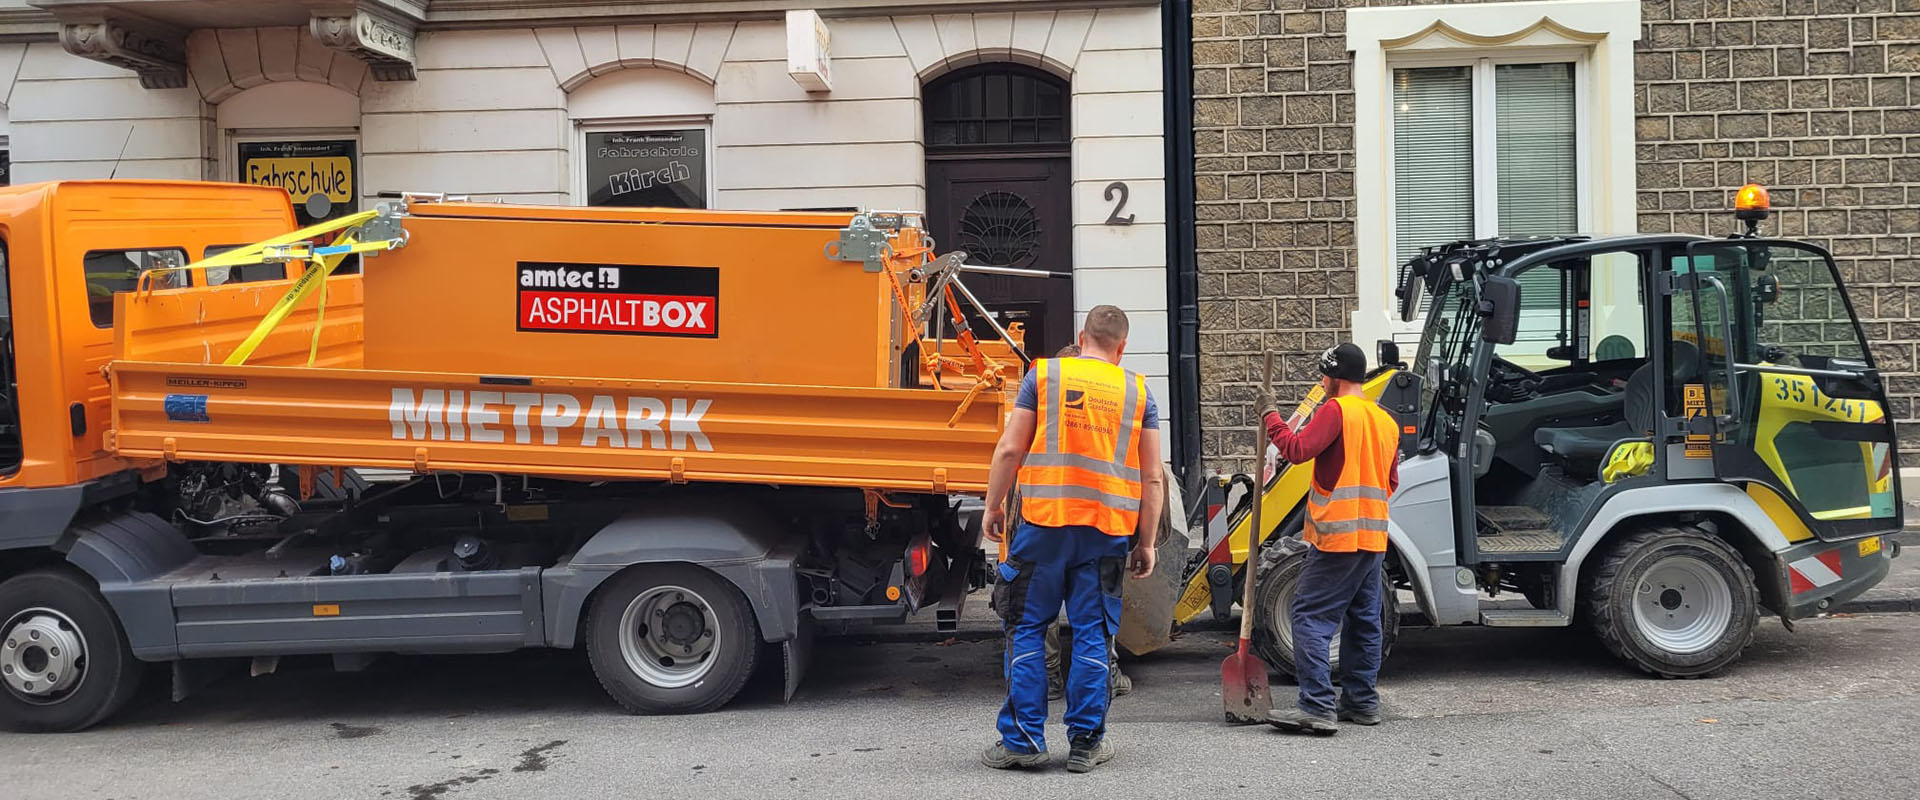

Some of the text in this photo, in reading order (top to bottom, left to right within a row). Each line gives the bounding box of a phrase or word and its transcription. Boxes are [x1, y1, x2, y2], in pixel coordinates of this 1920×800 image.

[597, 146, 700, 158] Fahrschule
[609, 160, 691, 196] Kirch
[1104, 181, 1136, 226] 2
[520, 266, 594, 288] amtec
[528, 297, 706, 329] ASPHALTBOX
[388, 387, 715, 453] MIETPARK
